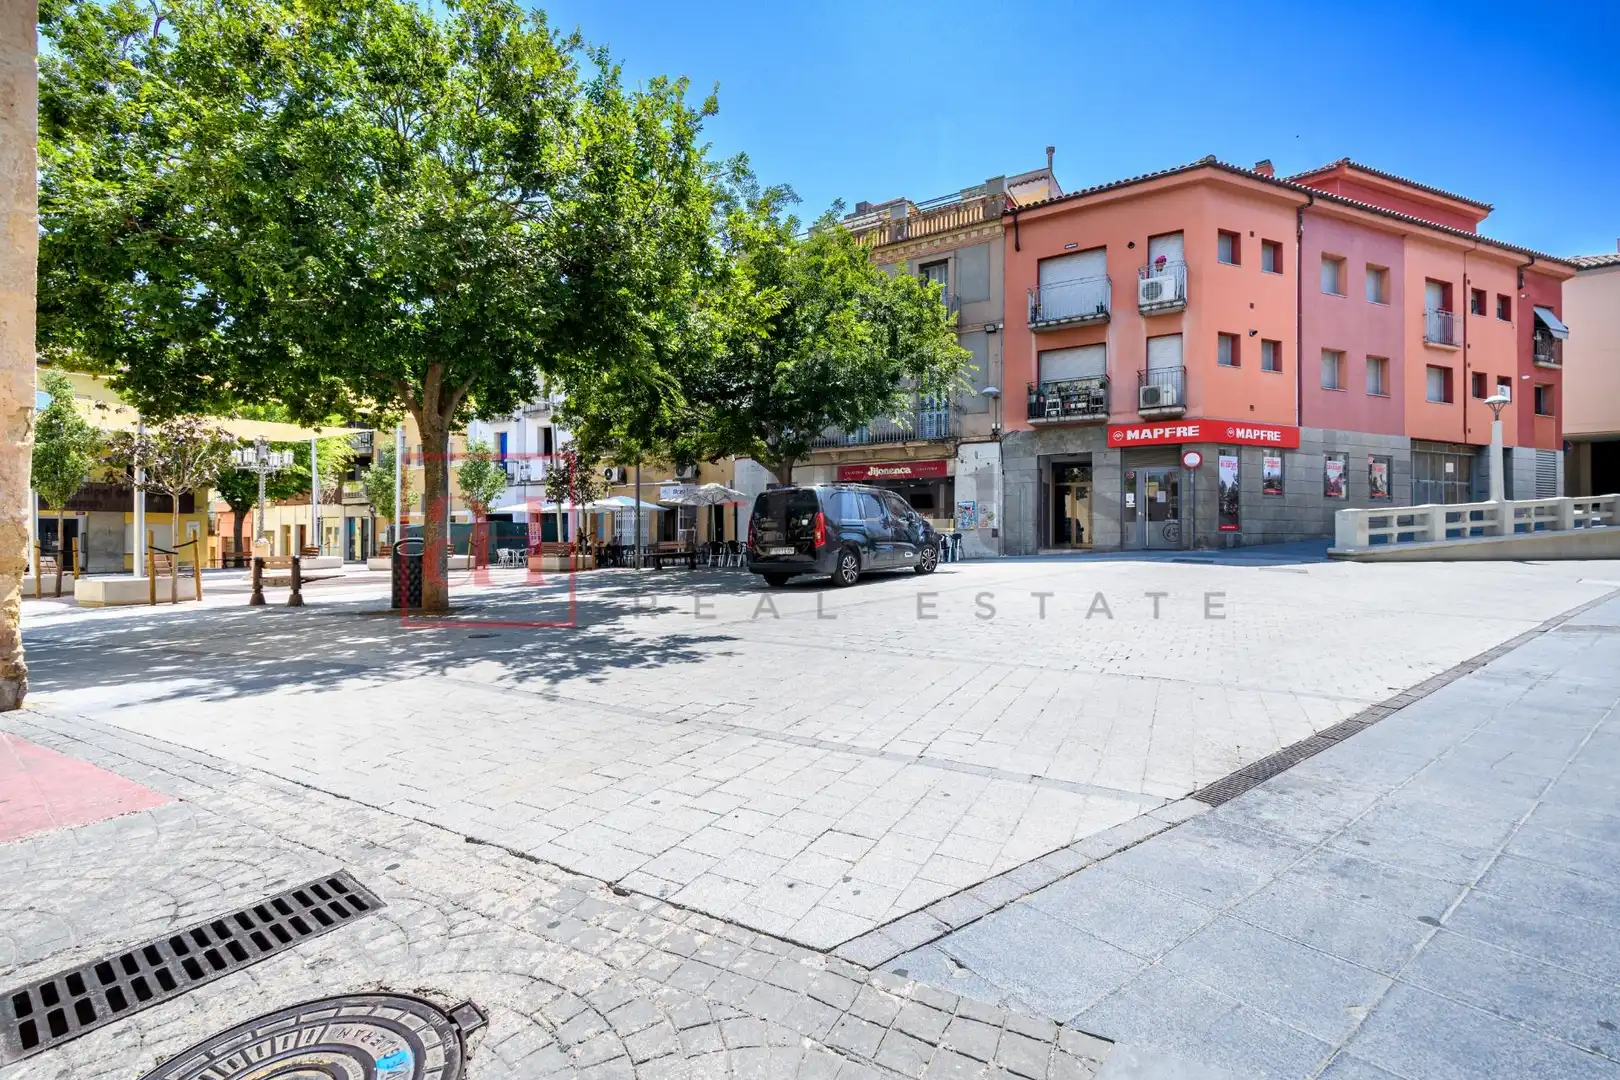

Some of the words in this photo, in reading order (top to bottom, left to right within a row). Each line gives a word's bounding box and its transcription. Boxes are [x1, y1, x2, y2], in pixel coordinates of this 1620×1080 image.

[1126, 425, 1200, 440] MAPFRE
[1236, 427, 1281, 441] MAPFRE
[867, 466, 911, 477] Jijonenca
